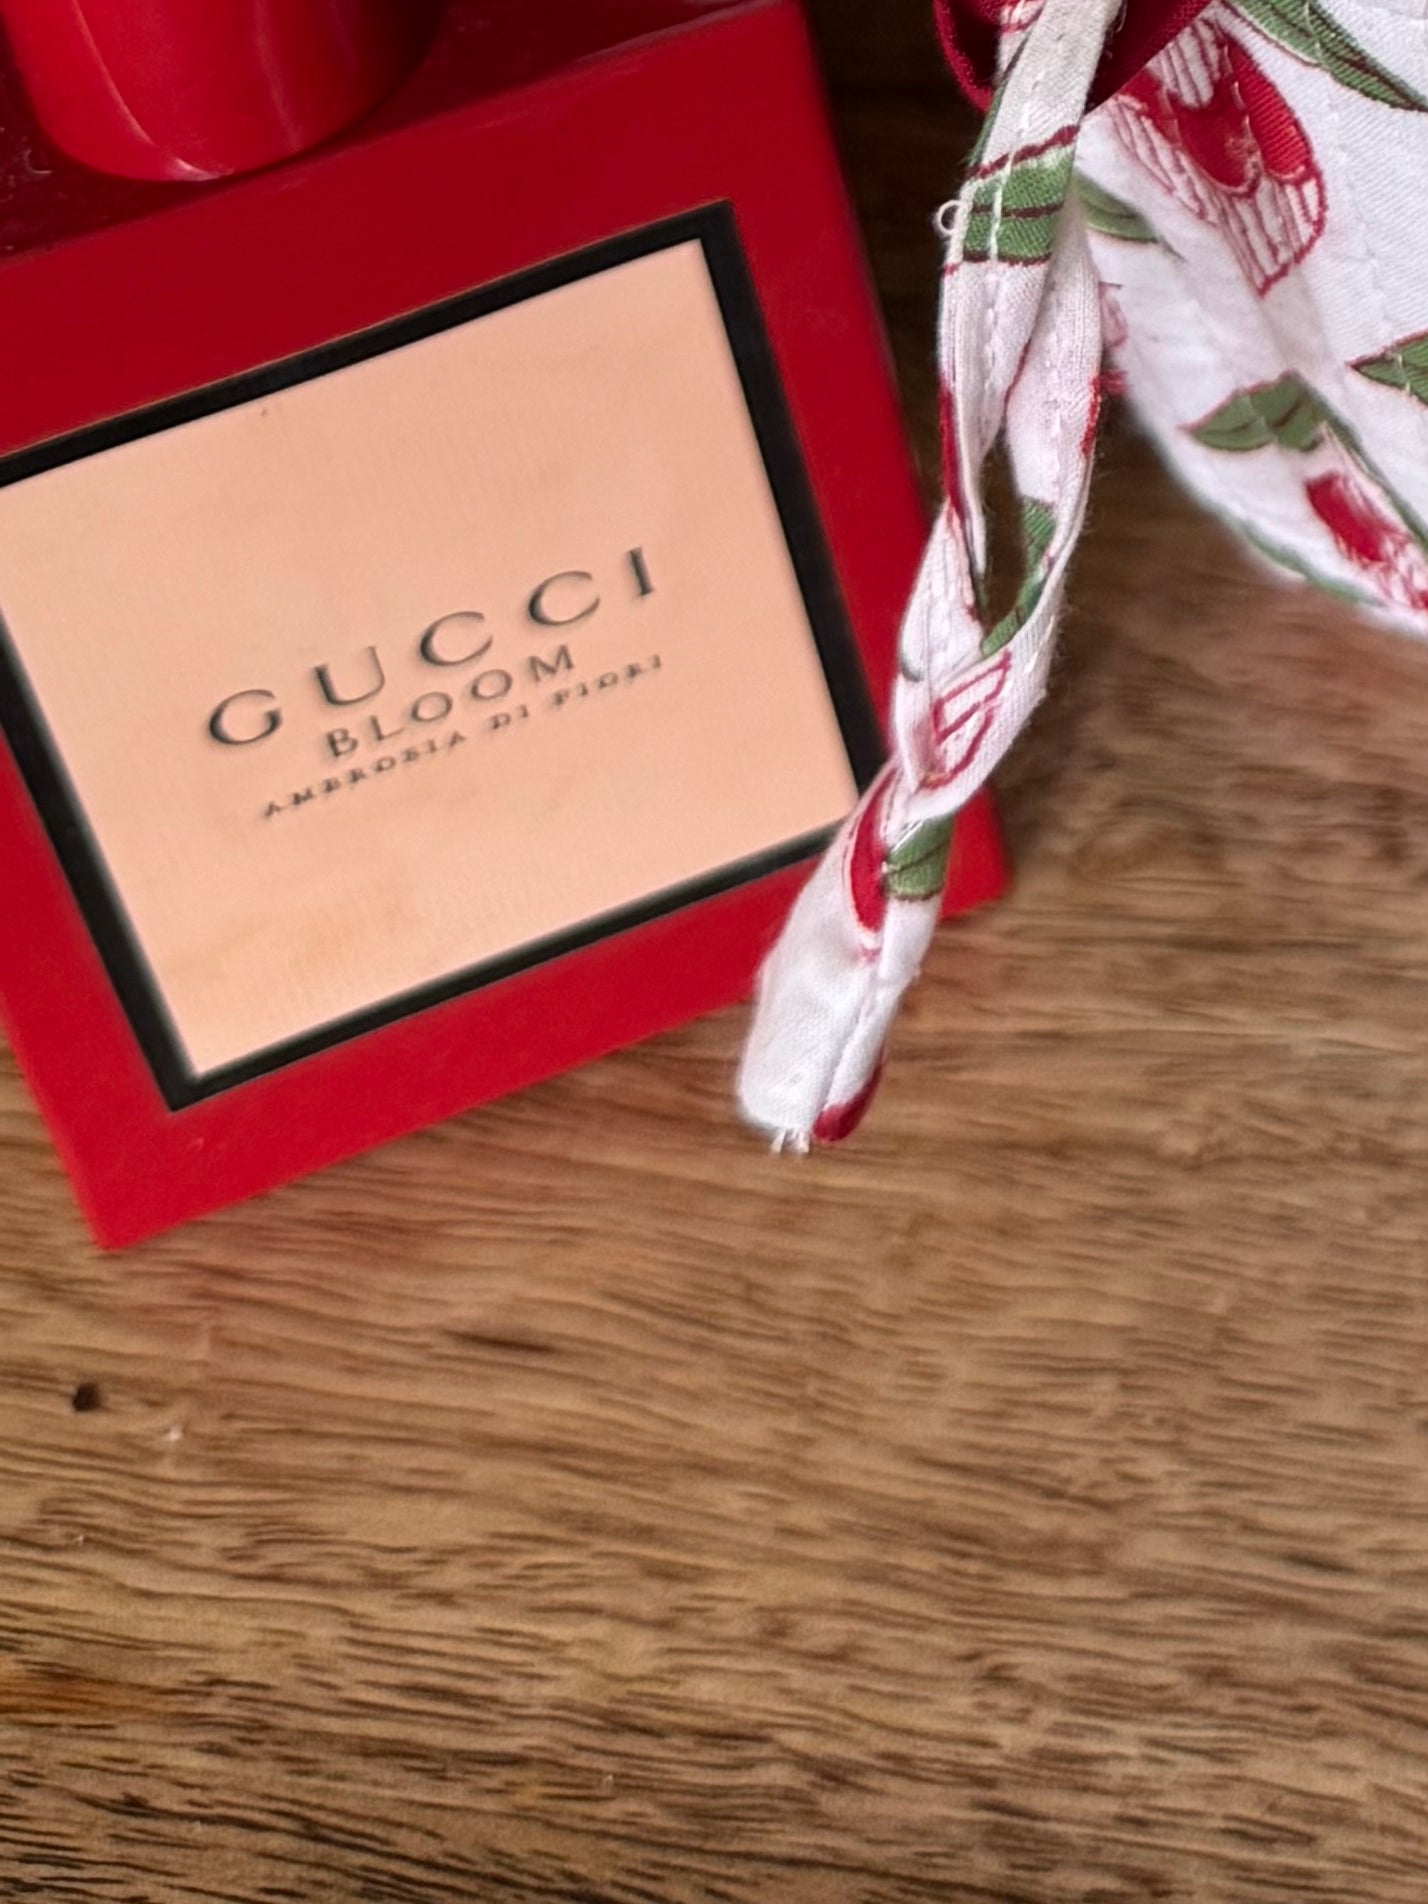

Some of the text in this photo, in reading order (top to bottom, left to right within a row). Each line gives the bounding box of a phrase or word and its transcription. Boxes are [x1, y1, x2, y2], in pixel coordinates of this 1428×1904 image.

[207, 545, 655, 746] GUCCI
[325, 643, 576, 759] BLOOM
[262, 654, 663, 819] AMBROSIA DI FIORI
